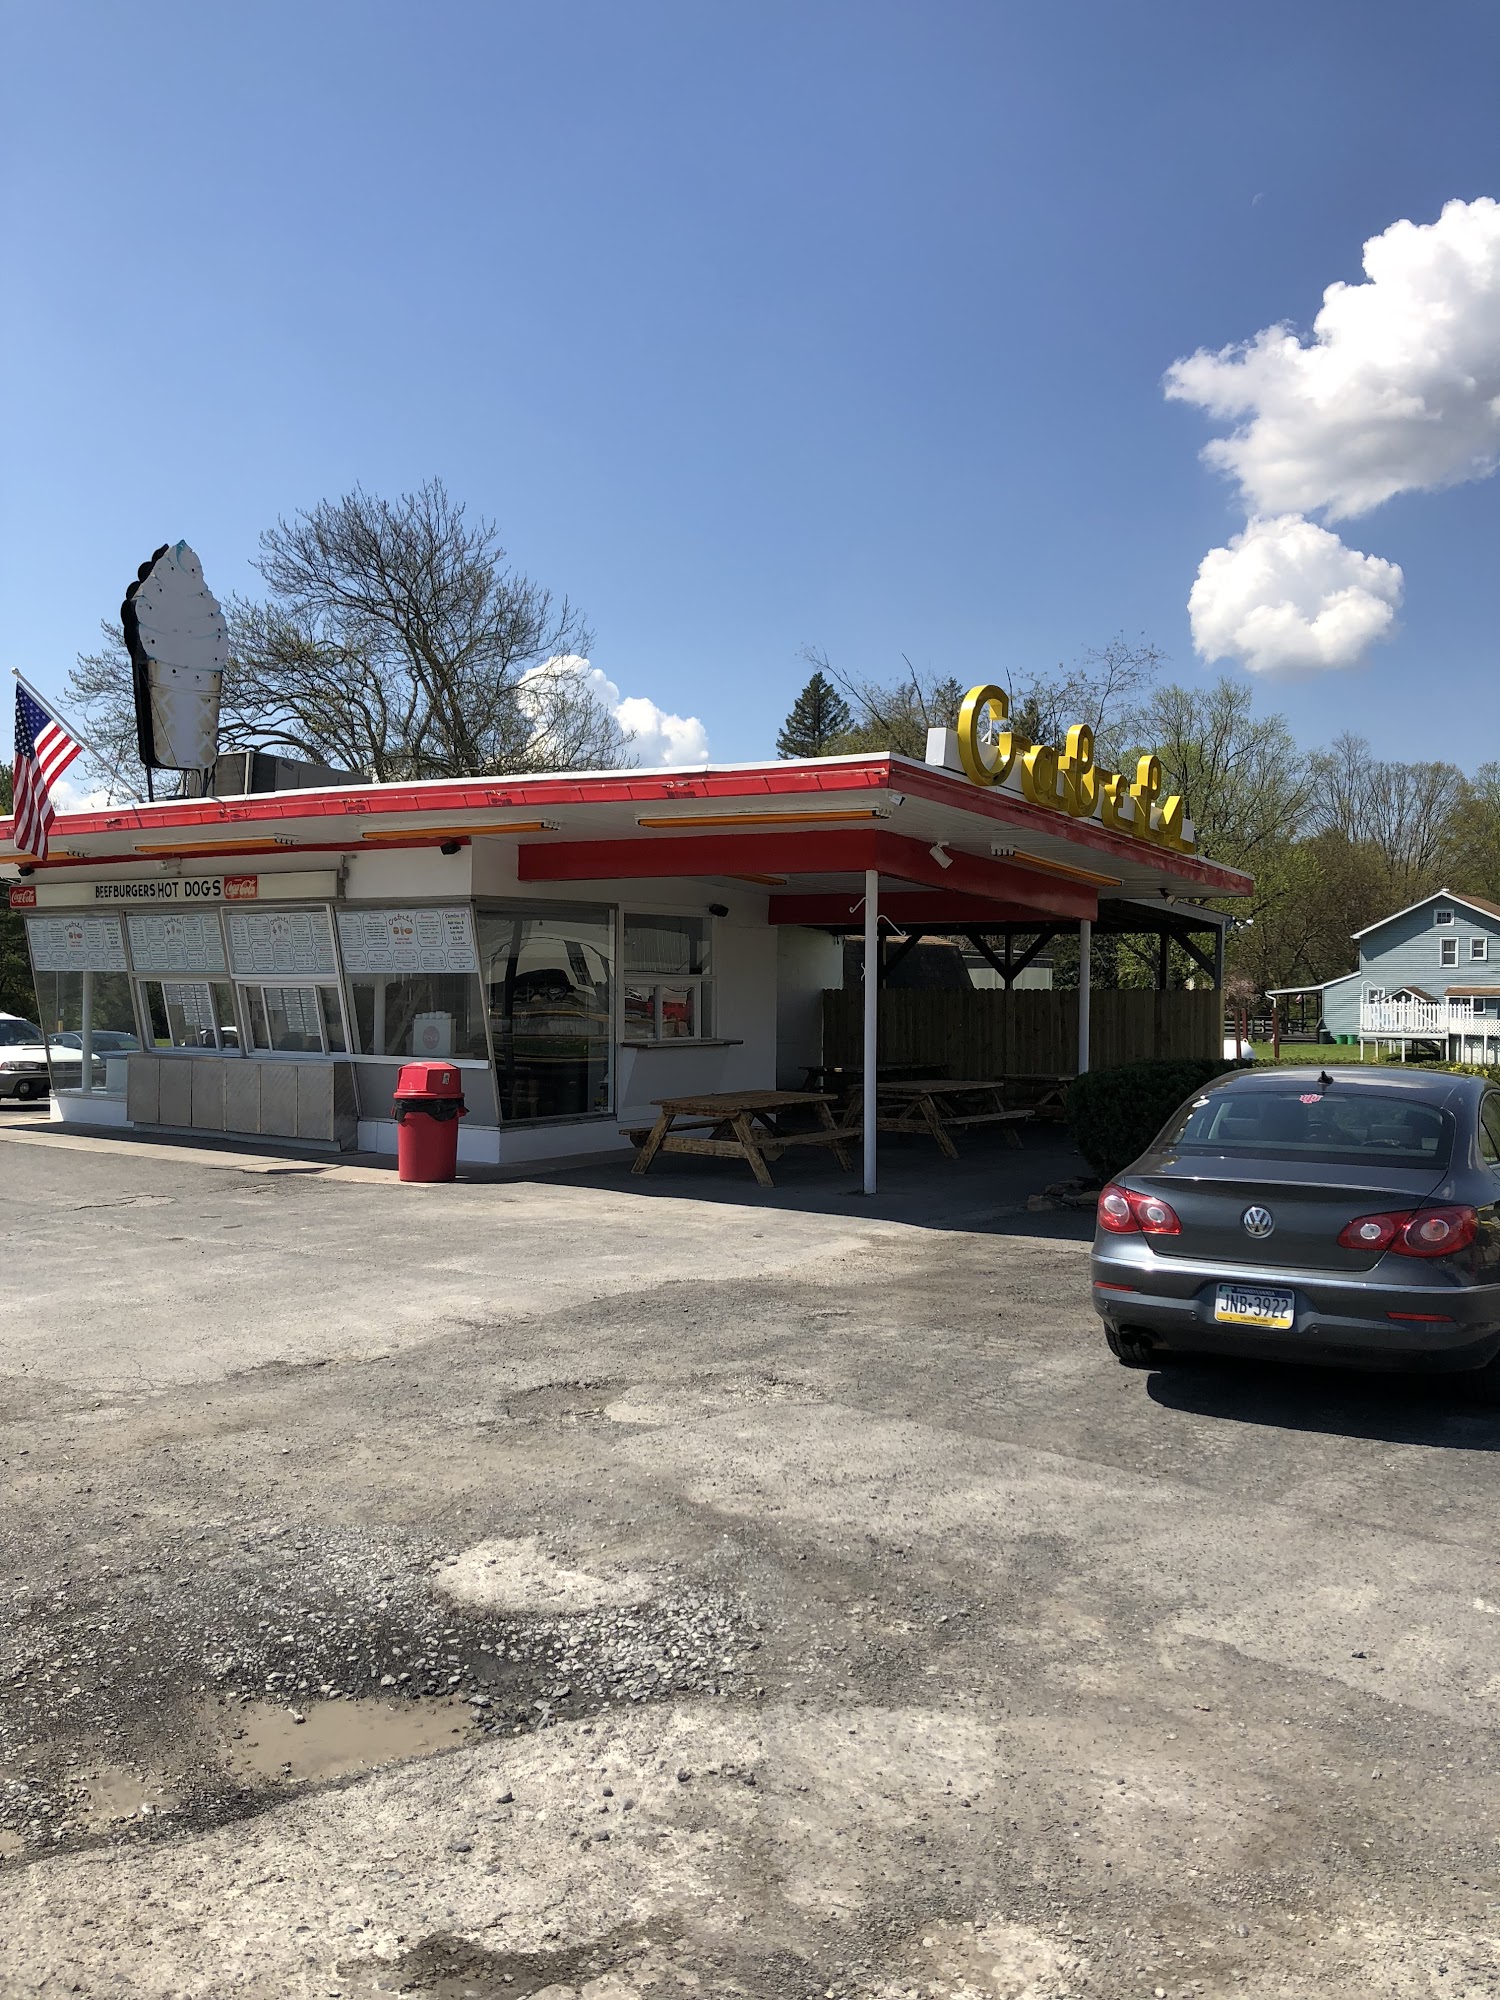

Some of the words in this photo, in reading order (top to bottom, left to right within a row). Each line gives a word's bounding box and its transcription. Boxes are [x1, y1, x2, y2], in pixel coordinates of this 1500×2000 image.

[95, 883, 155, 898] BEEFBURGERS
[157, 882, 179, 898] HOT
[184, 880, 221, 897] DOGS
[225, 879, 257, 896] Coca-Cola
[11, 890, 35, 903] Coca-Cola
[1236, 1287, 1276, 1297] PENNSYLVANIA
